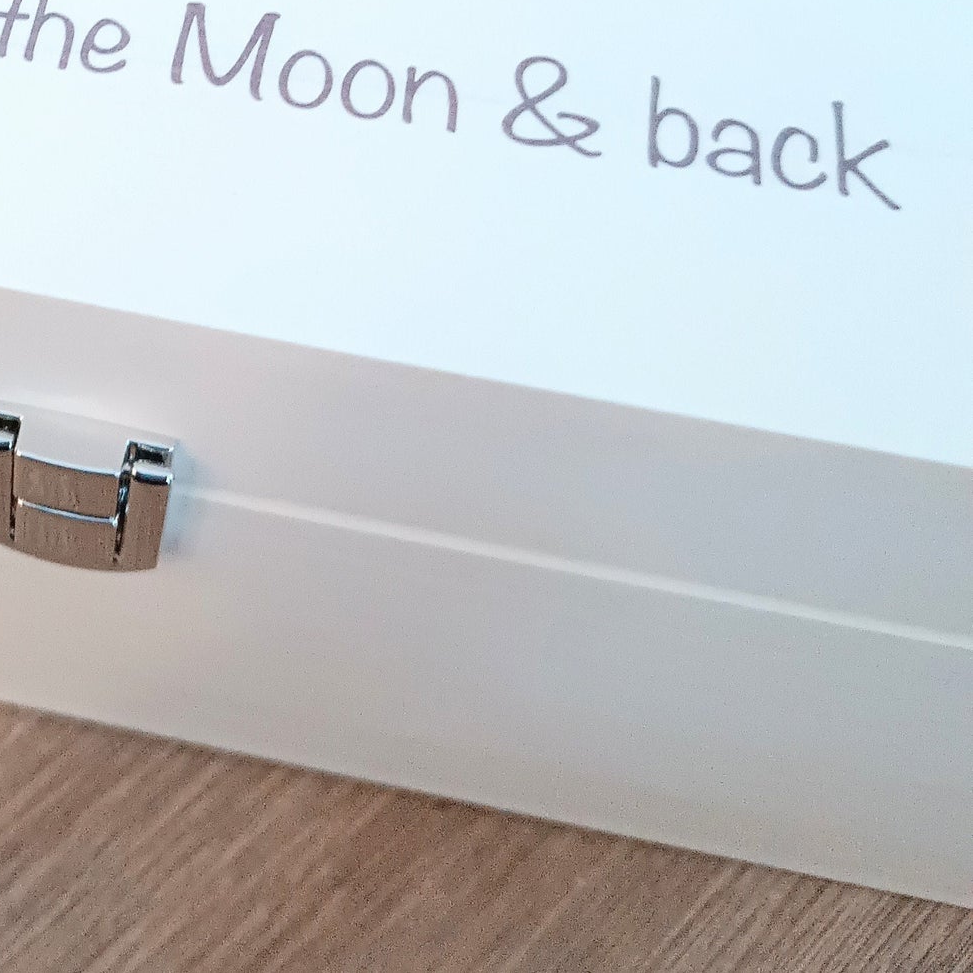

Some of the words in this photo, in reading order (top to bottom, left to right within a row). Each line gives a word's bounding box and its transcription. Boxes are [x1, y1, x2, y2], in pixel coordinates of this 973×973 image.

[169, 0, 460, 135] Moon
[500, 54, 604, 160] &
[646, 74, 904, 212] back
